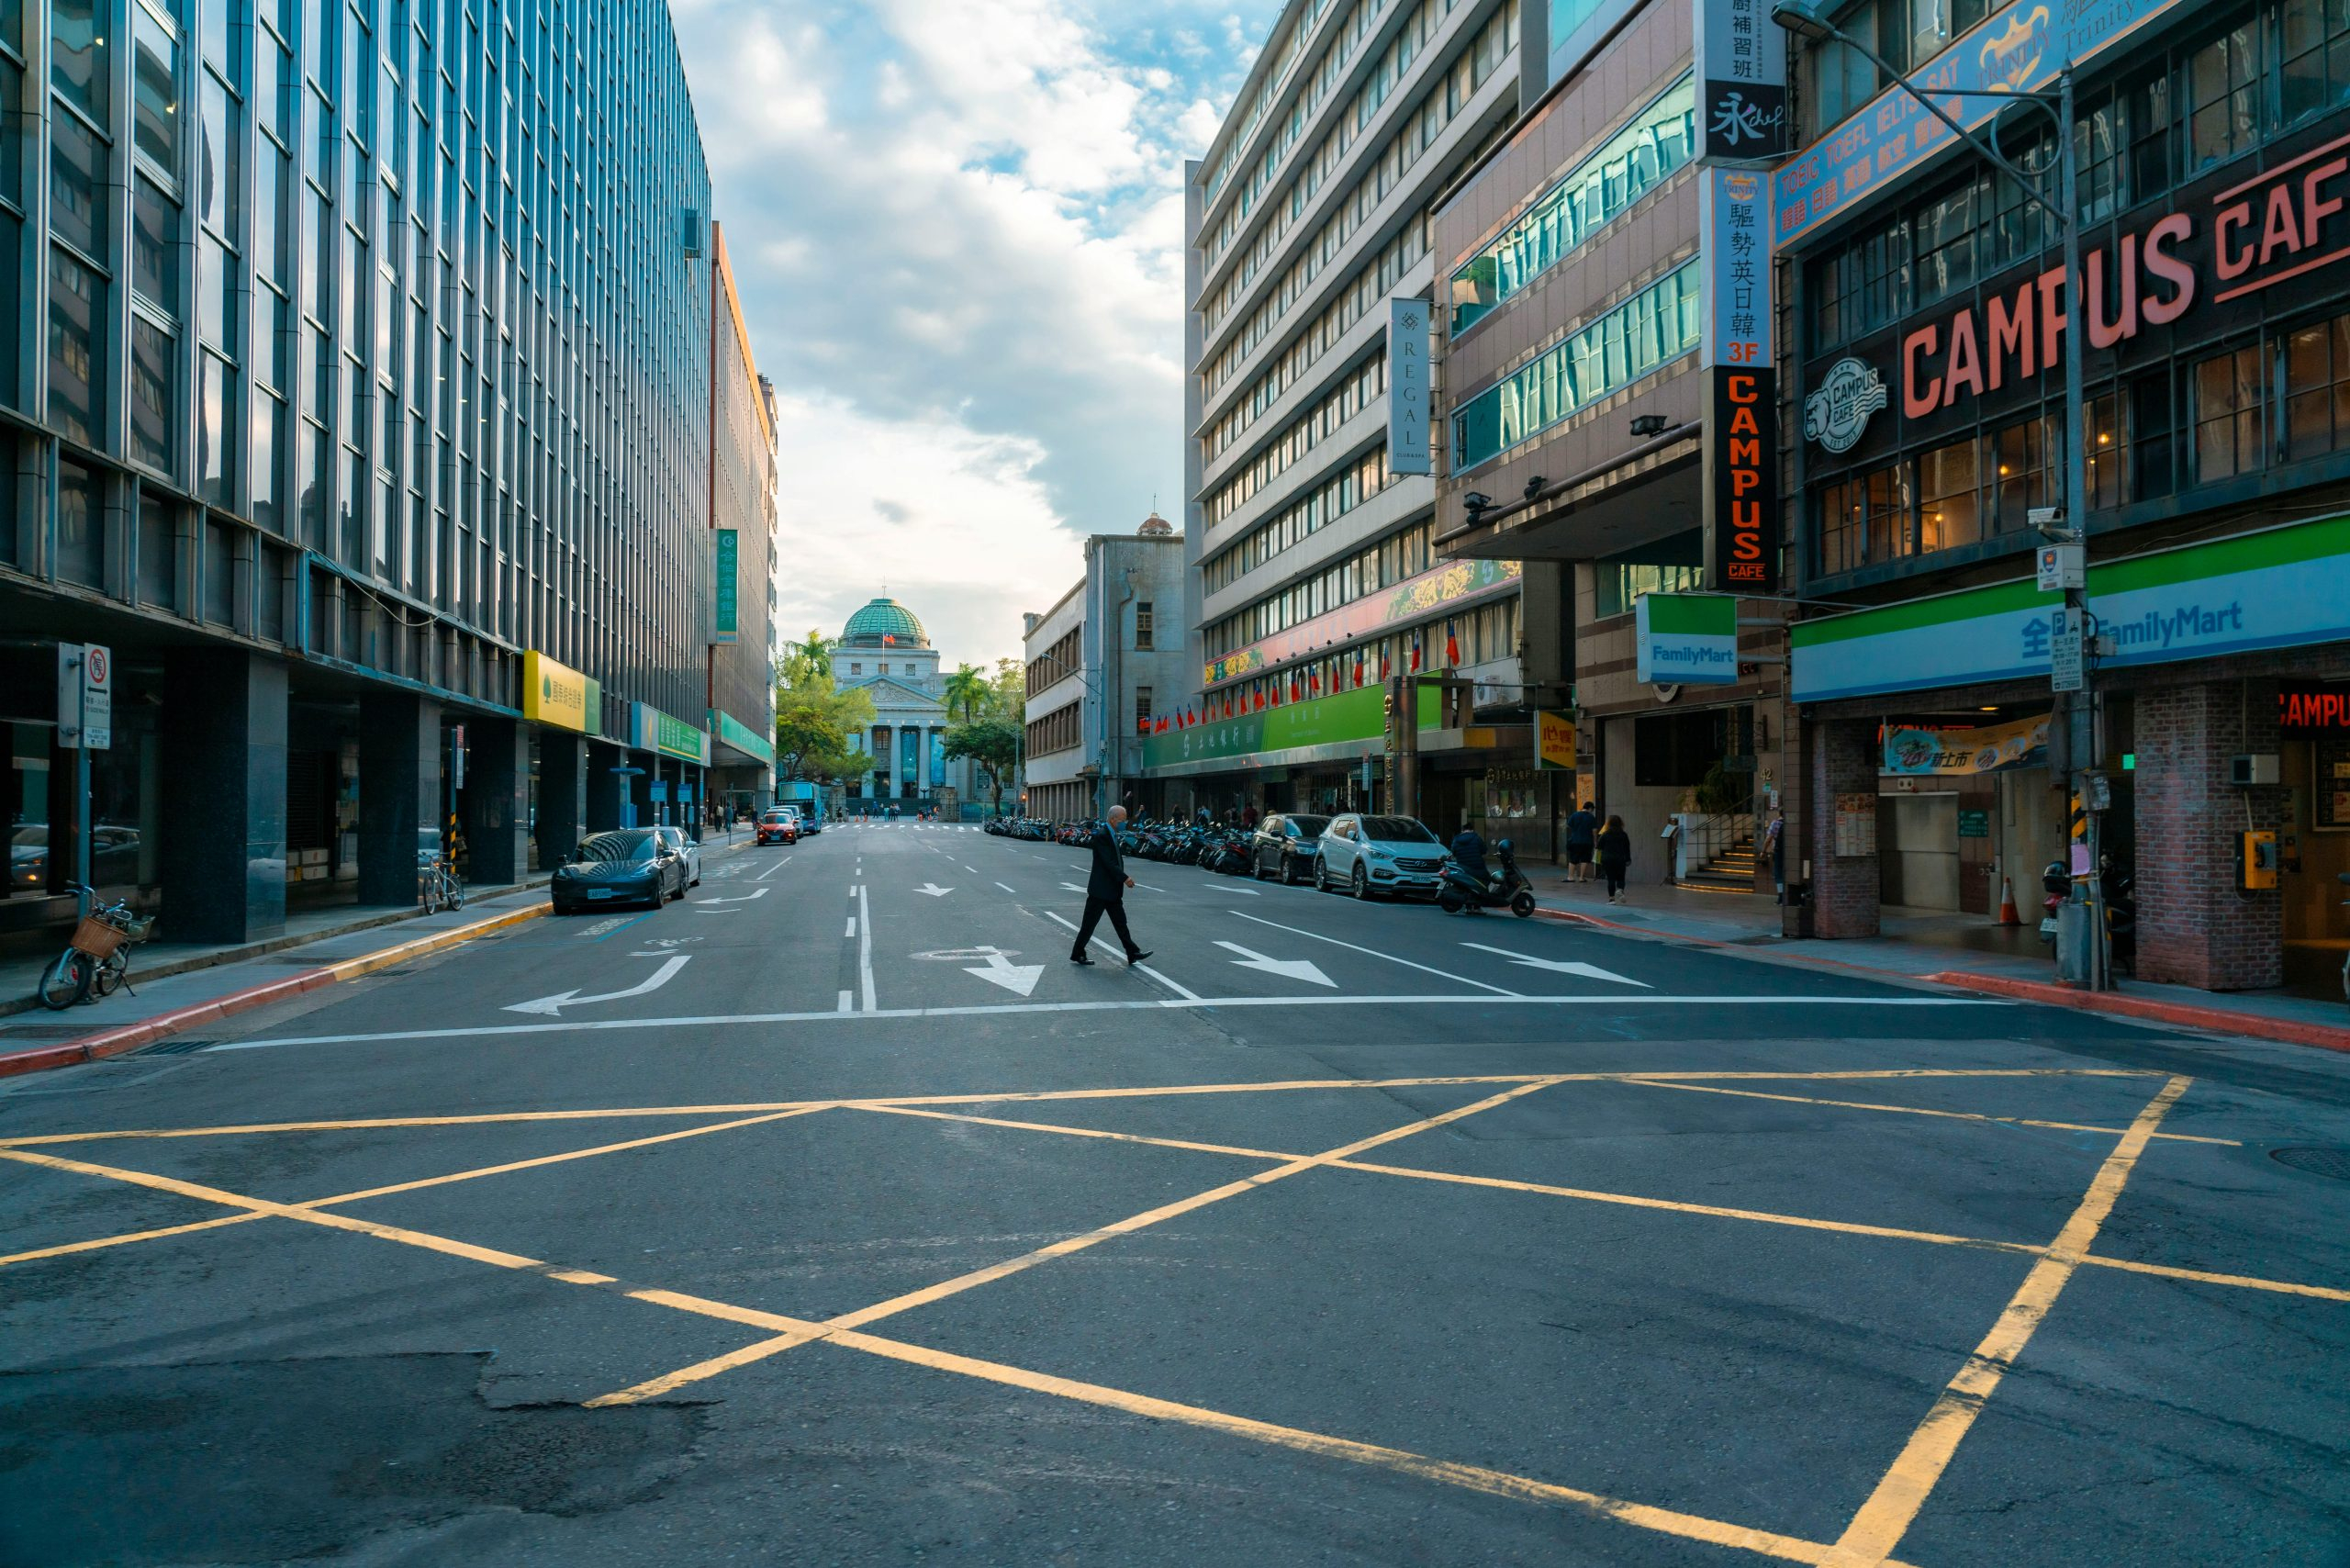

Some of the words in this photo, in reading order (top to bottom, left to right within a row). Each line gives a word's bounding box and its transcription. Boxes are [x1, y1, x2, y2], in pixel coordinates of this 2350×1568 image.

[1976, 25, 2053, 91] TRINITY
[1708, 92, 1766, 146] 永
[1782, 155, 1819, 198] TOEIC
[1825, 122, 1871, 169] TOEFL
[1876, 93, 1919, 136] IELTS
[1928, 55, 1961, 100] SAT
[1722, 184, 1761, 196] TRINITY
[1812, 176, 1838, 215] 日語
[1903, 212, 2196, 420] CAMPUS
[1727, 342, 1759, 364] 3F
[1404, 342, 1417, 445] REGAL
[1833, 369, 1878, 405] CAMPUS
[1833, 404, 1855, 423] CAFE
[1728, 375, 1762, 561] CAMPUS
[1729, 565, 1765, 578] CAFE
[1652, 644, 1734, 666] FamilyMart
[1930, 751, 1974, 768] 新上市
